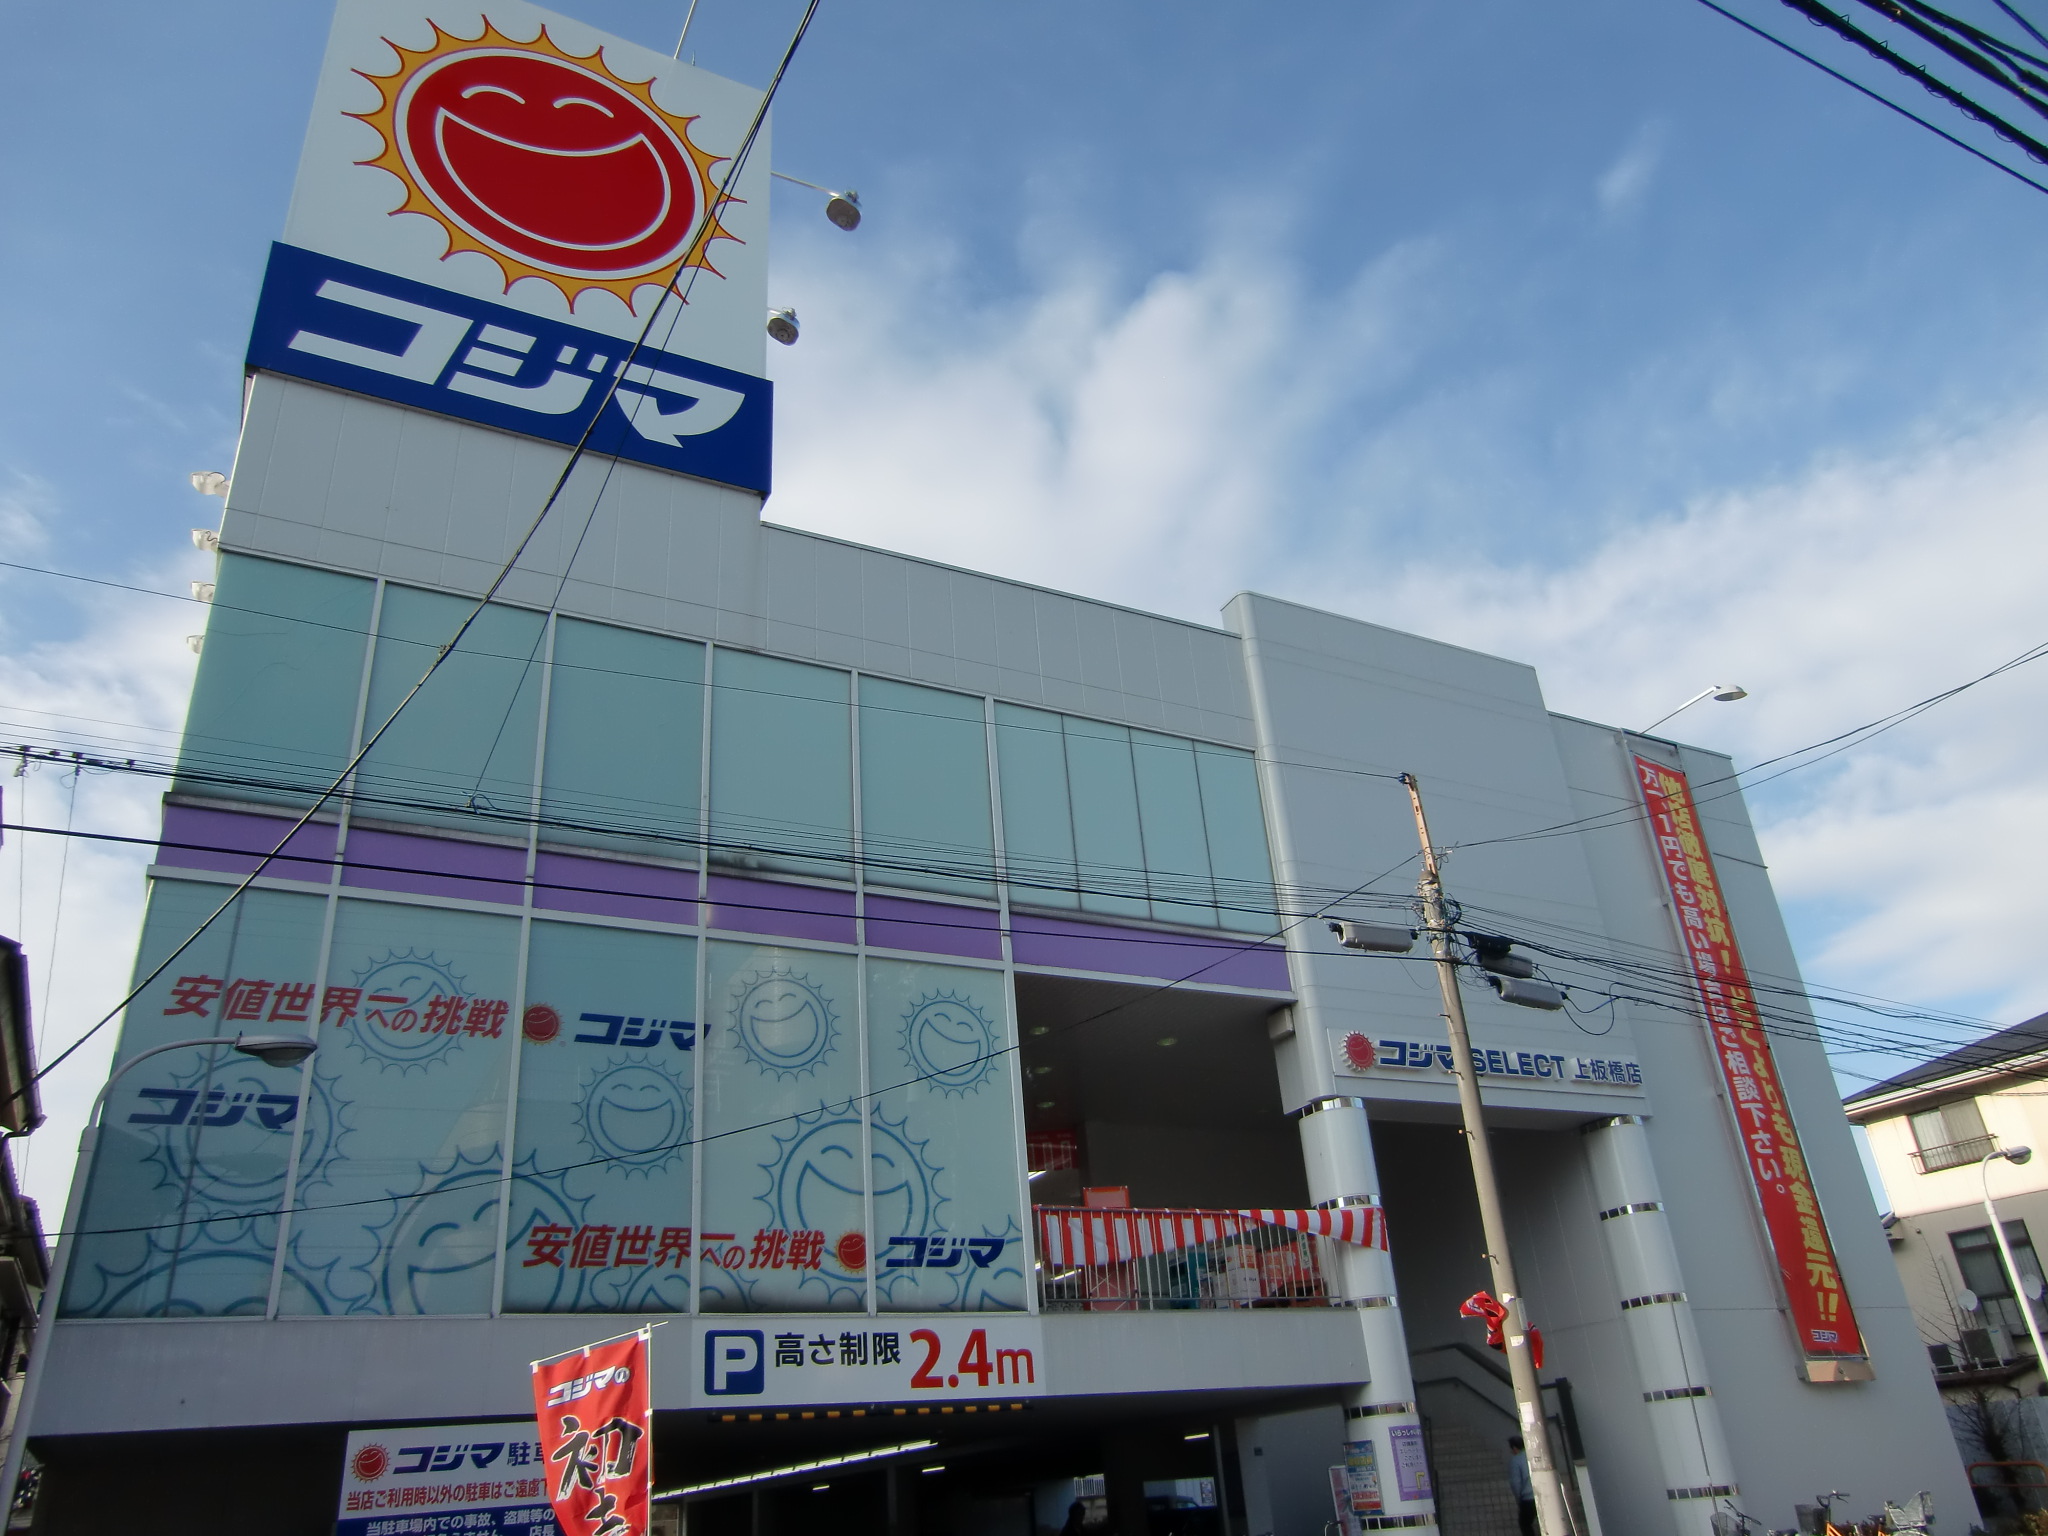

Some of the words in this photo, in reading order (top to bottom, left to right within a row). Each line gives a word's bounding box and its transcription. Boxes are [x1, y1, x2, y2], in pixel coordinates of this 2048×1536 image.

[287, 279, 746, 449] コジマ
[163, 974, 509, 1039] 安値世界一への挑戦
[574, 1012, 712, 1052] コジマ
[1379, 1039, 1453, 1070] コジマ
[1471, 1048, 1565, 1080] SELECT
[1574, 1057, 1644, 1086] 上板橋店
[127, 1087, 312, 1131] コジマ
[522, 1222, 826, 1272] 安値世界一への挑戦
[886, 1236, 1005, 1269] コジマ
[713, 1336, 758, 1391] P
[774, 1331, 901, 1368] 高さ制限
[908, 1327, 1036, 1389] 2.4m
[1811, 1328, 1839, 1344] コジマ
[546, 1365, 631, 1408] コジマの
